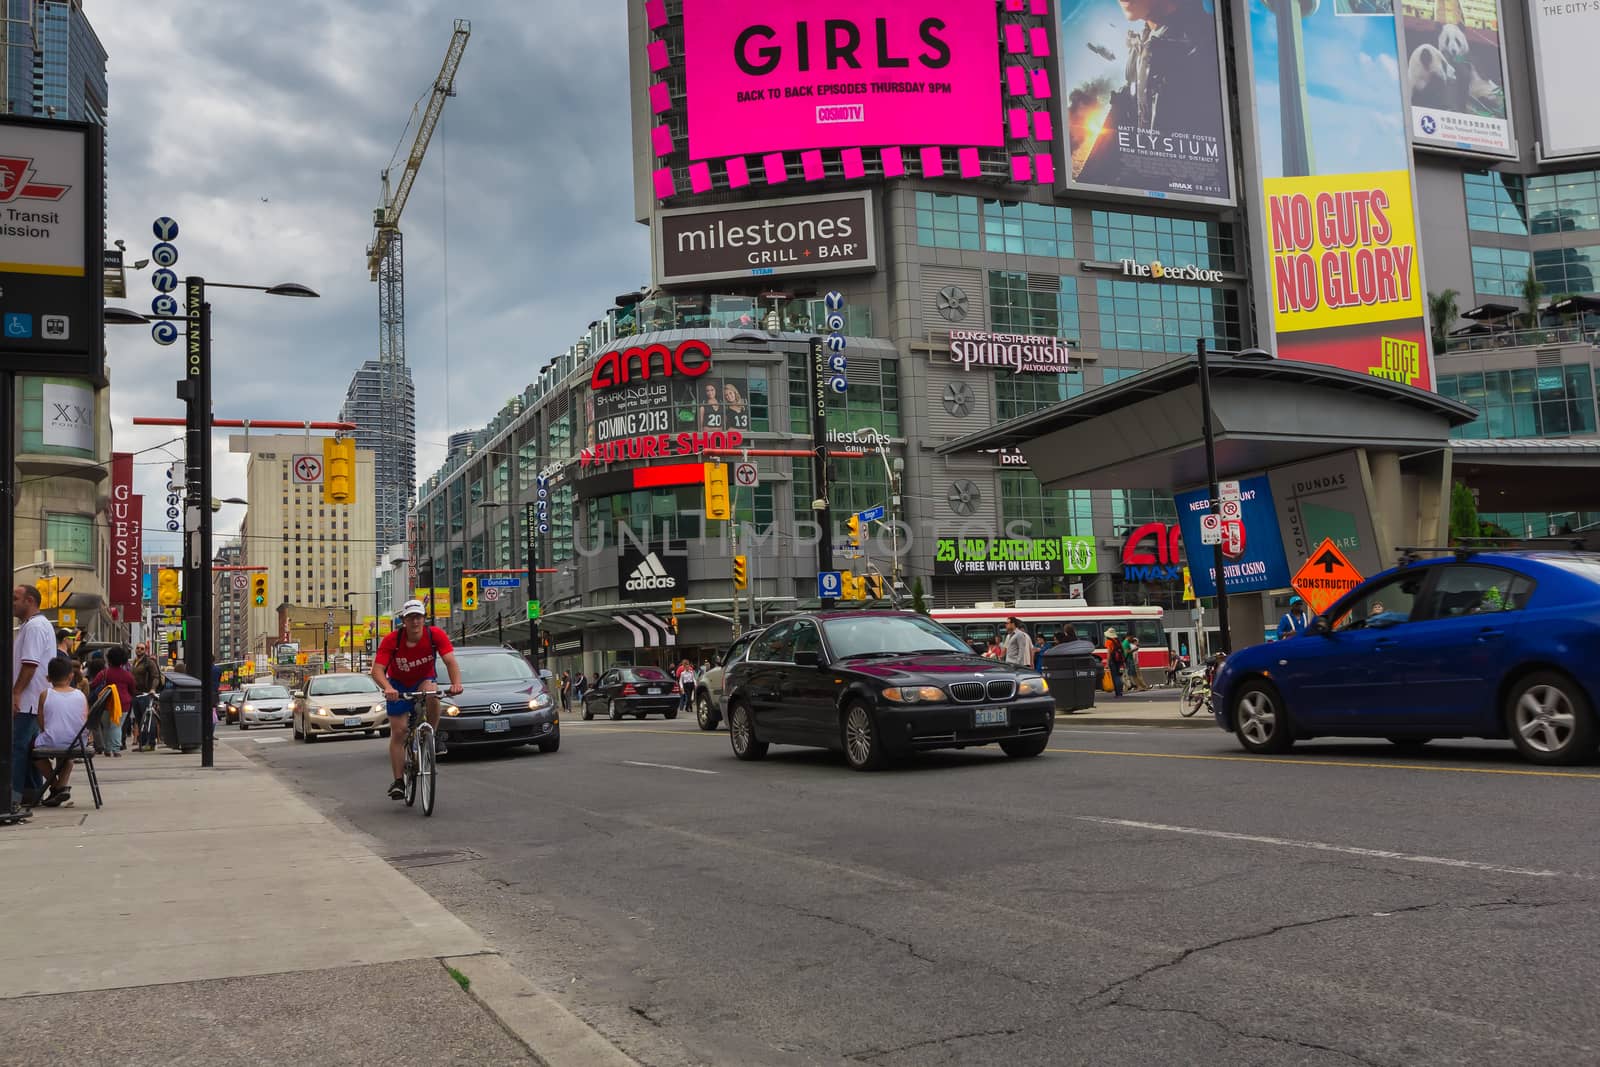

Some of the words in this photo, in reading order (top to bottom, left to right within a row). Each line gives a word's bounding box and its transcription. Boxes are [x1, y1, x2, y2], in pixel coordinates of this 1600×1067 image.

[1544, 5, 1562, 16] THE
[734, 18, 951, 76] GIRLS
[737, 90, 765, 102] BACK
[768, 88, 781, 99] TO
[784, 86, 813, 98] BACK
[817, 82, 867, 95] EPISODES
[870, 82, 925, 94] THURSDAY
[928, 82, 951, 94] 9PM
[1118, 132, 1218, 157] ELYSIUM
[6, 208, 60, 224] Transit
[1269, 193, 1314, 252] NO
[1316, 189, 1391, 248] GUTS
[678, 217, 852, 252] milestones
[747, 249, 798, 264] GRILL
[1274, 253, 1318, 313] NO
[1321, 245, 1413, 308] GLORY
[190, 284, 201, 376] DOWNTOWN
[951, 330, 988, 341] LOUNGE
[992, 333, 1049, 345] RESTAURANT
[825, 291, 848, 393] Yonge
[1384, 341, 1417, 374] EDGE
[815, 344, 825, 417] DOWNTOWN
[597, 392, 625, 406] SHARK
[598, 414, 636, 440] COMING
[639, 410, 668, 433] 2013
[708, 414, 722, 427] 20
[734, 415, 748, 427] 13
[594, 434, 670, 466] FUTURE
[677, 431, 743, 456] SHOP
[1297, 473, 1345, 492] DUNDAS
[1190, 500, 1209, 511] NEED
[1240, 490, 1256, 501] UN?
[114, 485, 128, 575] GUESS
[1288, 507, 1305, 557] YONGE
[936, 539, 956, 561] 25
[959, 539, 987, 561] FAB
[990, 539, 1061, 561] EATERIES!
[1313, 536, 1358, 549] SARE
[965, 561, 984, 571] FREE
[987, 561, 1006, 570] WI-FI
[1008, 561, 1019, 570] ON
[1021, 560, 1043, 570] LEVEL
[1045, 560, 1050, 570] 3
[1124, 565, 1180, 581] IMAX
[1241, 560, 1266, 576] CASINO
[625, 575, 677, 591] adidas
